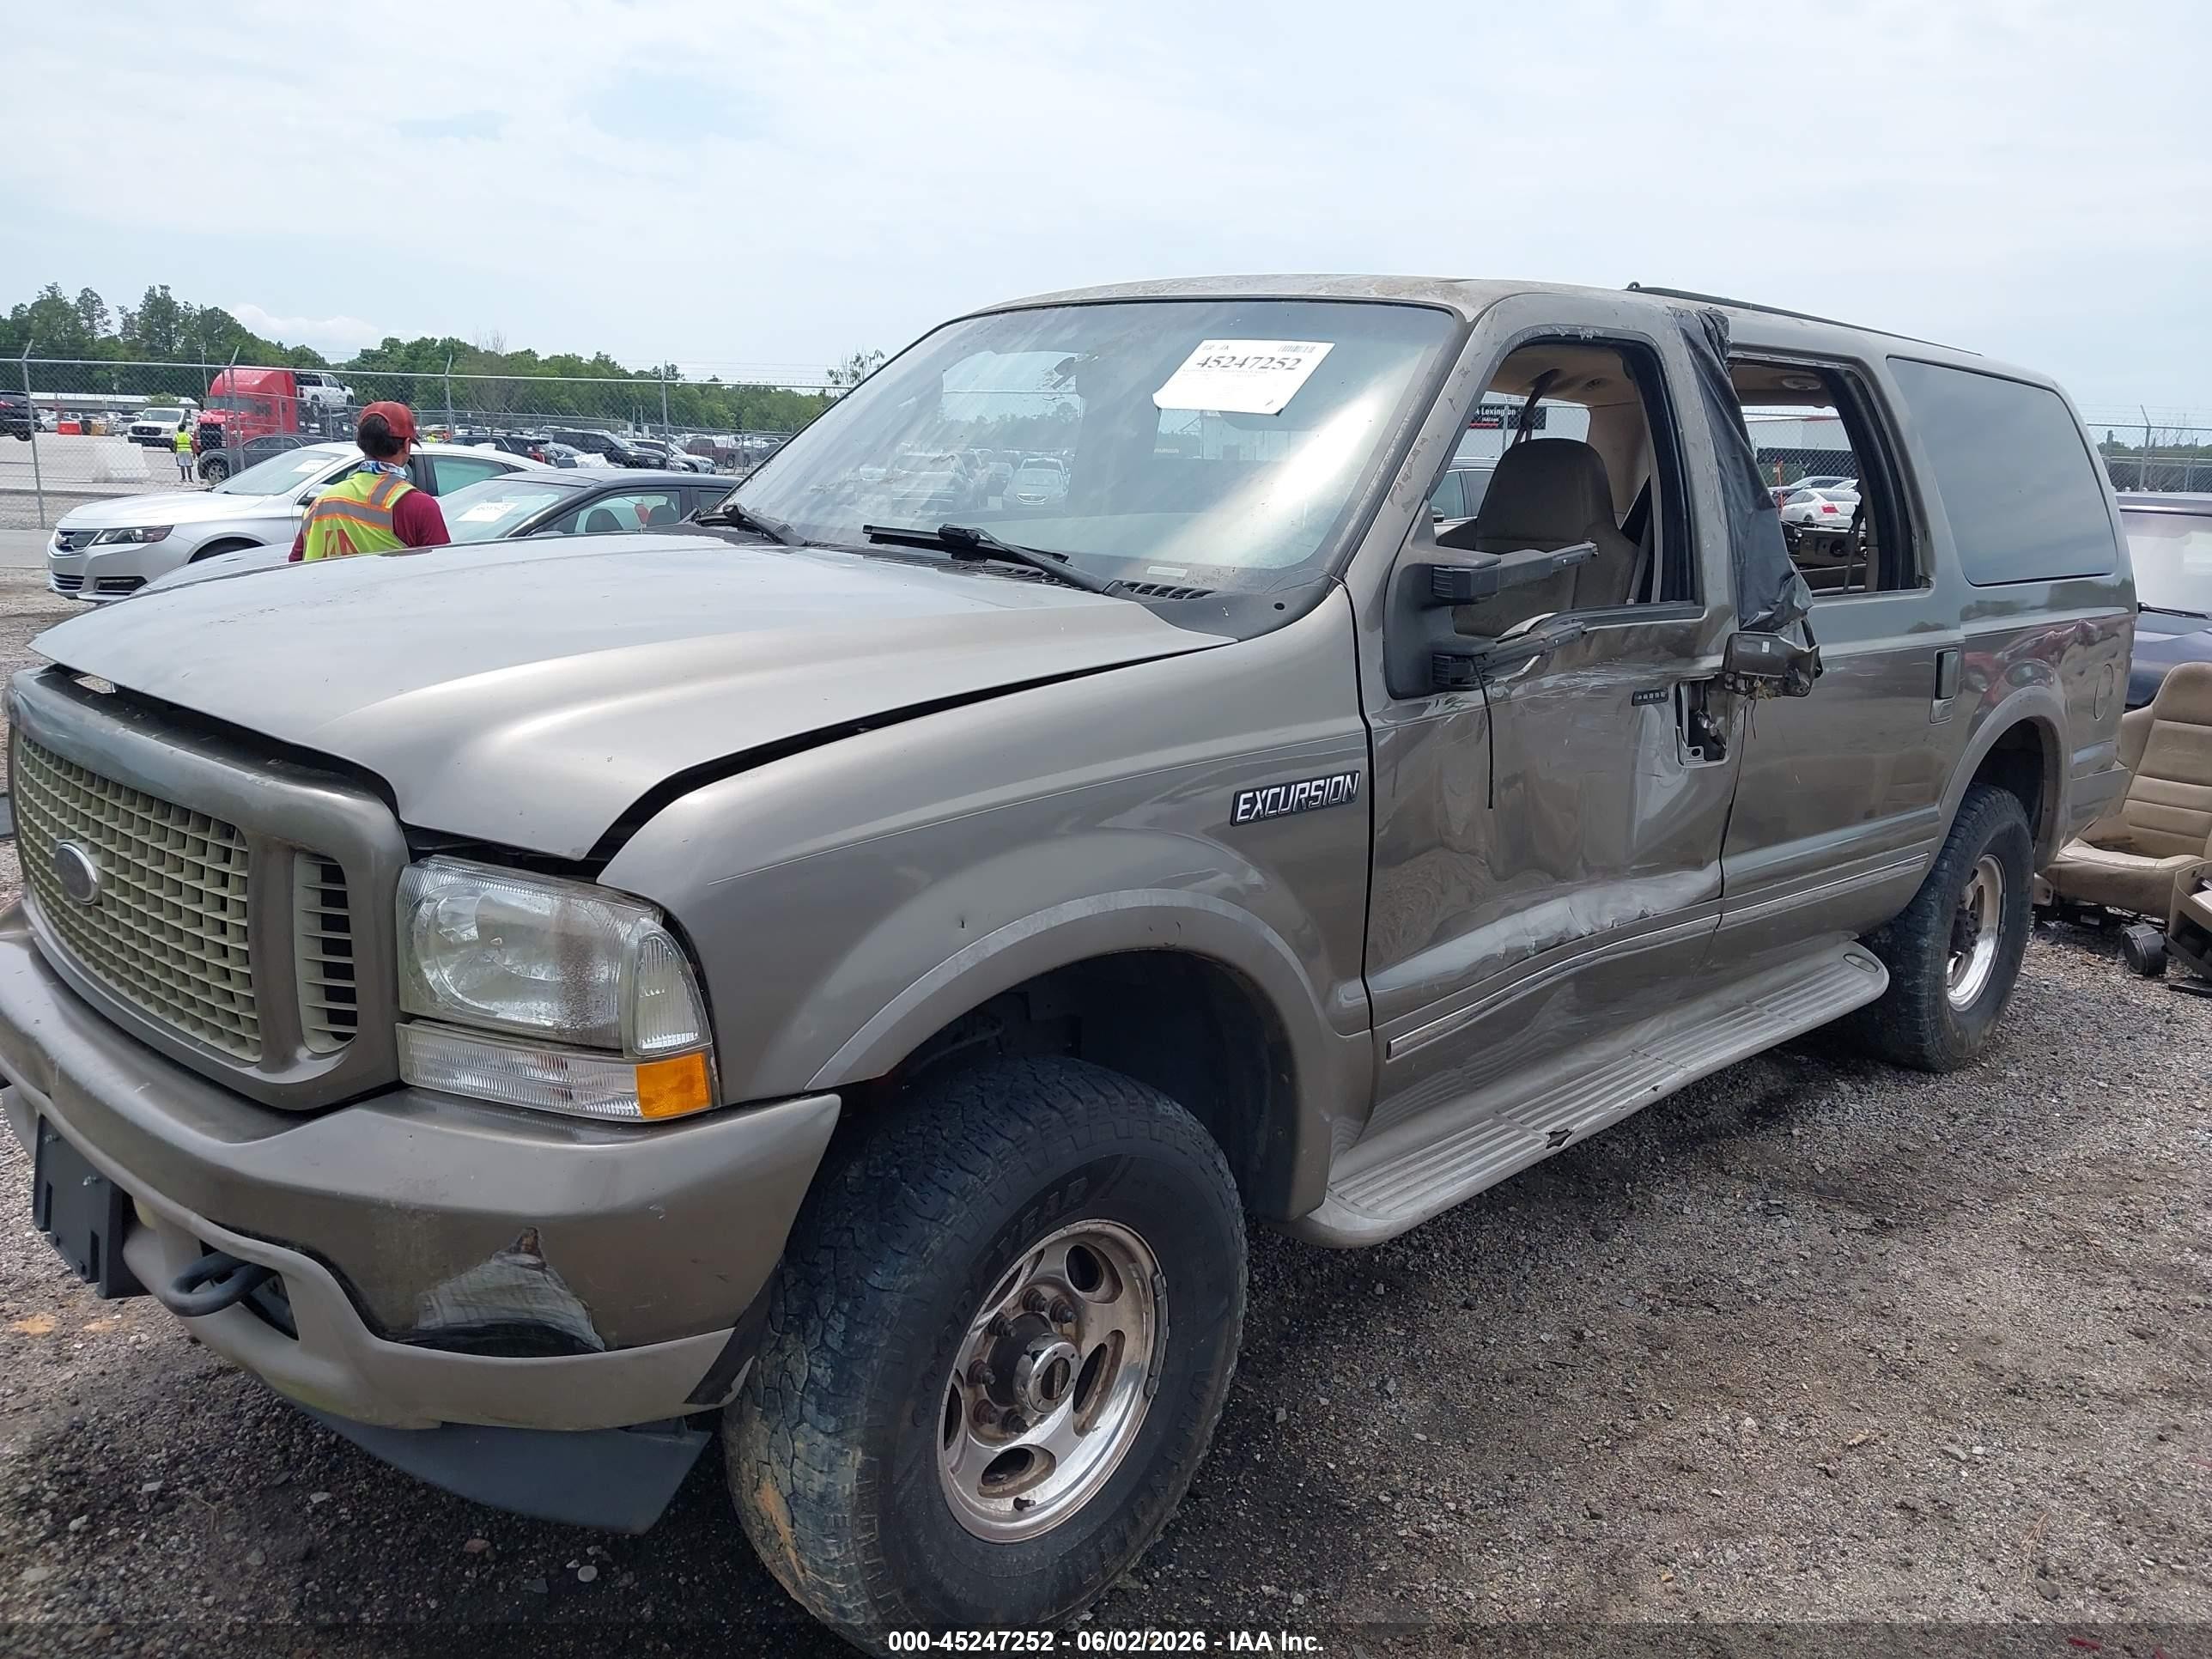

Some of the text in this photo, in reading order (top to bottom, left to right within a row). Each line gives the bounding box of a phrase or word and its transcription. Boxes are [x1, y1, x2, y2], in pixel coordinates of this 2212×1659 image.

[1196, 356, 1303, 371] 45247252
[1481, 407, 1516, 417] Lexingon
[1236, 773, 1359, 822] EXCURSION
